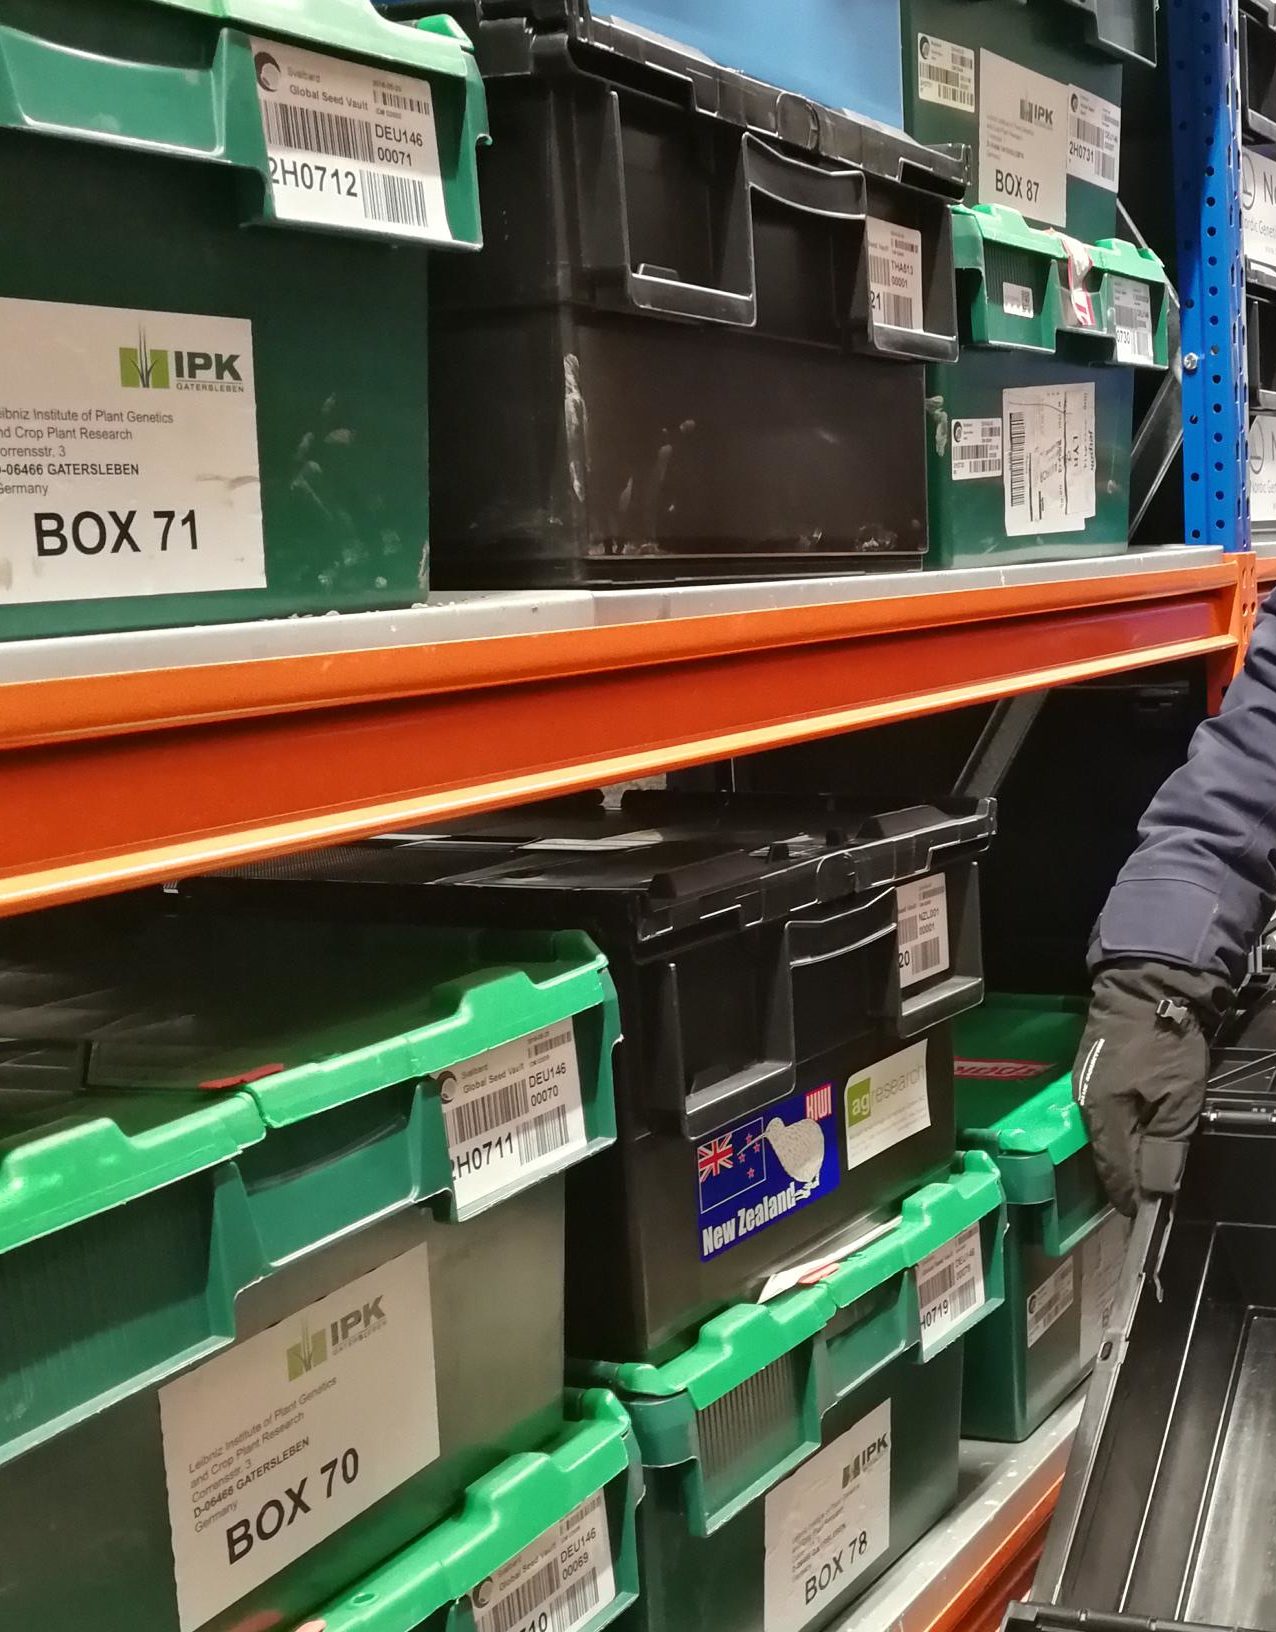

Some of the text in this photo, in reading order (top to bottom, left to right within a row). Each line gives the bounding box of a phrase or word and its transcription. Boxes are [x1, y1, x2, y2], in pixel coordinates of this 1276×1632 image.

[289, 84, 369, 111] Global Seed Vault
[1034, 104, 1054, 126] IPK
[375, 124, 424, 147] DEU146
[377, 146, 413, 167] 00071
[995, 169, 1040, 203] BOX 87
[174, 350, 242, 381] IPK
[176, 382, 244, 393] GATERSLEBEN
[33, 408, 78, 422] Institute
[81, 409, 92, 421] of
[96, 409, 124, 423] Plant
[127, 410, 174, 424] Genetics
[15, 427, 44, 443] Crop
[47, 427, 76, 440] Plant
[80, 428, 133, 441] Research
[59, 446, 66, 457] 3
[47, 463, 139, 476] GATERSLEBEN
[34, 509, 199, 557] BOX 71
[463, 1078, 487, 1094] Global
[488, 1071, 507, 1084] Seed
[528, 1061, 567, 1089] DEU146
[530, 1084, 559, 1107] 00070
[806, 1085, 832, 1121] KIWI
[702, 1181, 797, 1257] New Zealand
[330, 1294, 386, 1347] IPK
[188, 1377, 337, 1474] Leibniz Institute of Plant Genetics
[190, 1412, 305, 1489] and Crop Plant Research
[862, 1432, 889, 1467] IPK
[193, 1436, 310, 1520] D-06466 GATERSLEBEN
[194, 1500, 239, 1534] Germany
[226, 1447, 359, 1565] BOX 70
[560, 1527, 597, 1563] DEU146
[562, 1552, 590, 1581] 00069
[805, 1549, 844, 1606] BOX
[849, 1530, 868, 1564] 78
